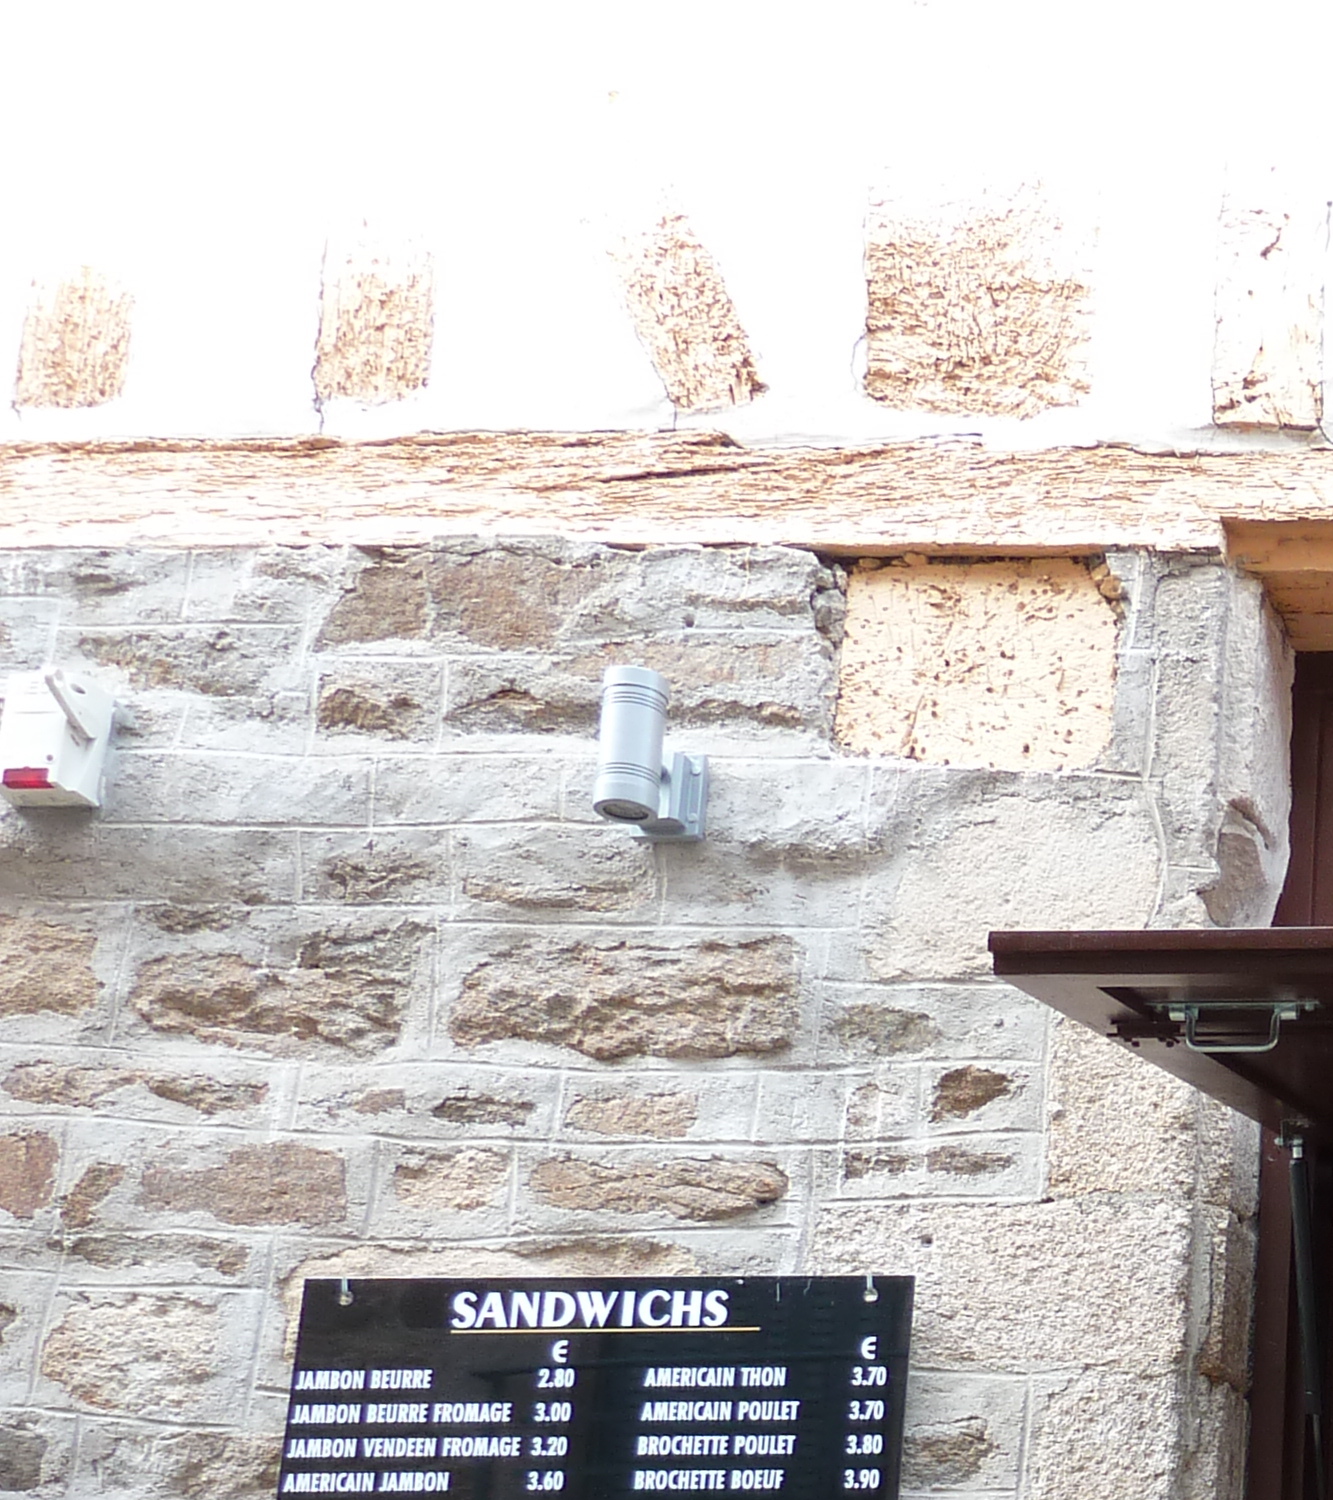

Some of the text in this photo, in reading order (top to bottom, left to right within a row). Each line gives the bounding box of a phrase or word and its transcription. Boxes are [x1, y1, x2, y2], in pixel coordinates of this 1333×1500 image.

[450, 1289, 729, 1329] SANDWICHS
[294, 1368, 575, 1391] JAMBON BEURRE 2.80
[642, 1366, 887, 1388] AMERICAIN THON 3.70
[289, 1402, 572, 1425] JAMBON BEURRE FROMAGE 3.00
[640, 1400, 885, 1422] AMERICAIN POULET 3.70
[285, 1436, 568, 1459] JAMBON VENDEEN FROMAGE 3.20
[636, 1434, 883, 1456] BROCHETTE POULET 3.80
[281, 1470, 564, 1493] AMERICAIN JAMBON 3.60
[633, 1468, 880, 1491] BROCHETTE BOEUF 3.90
